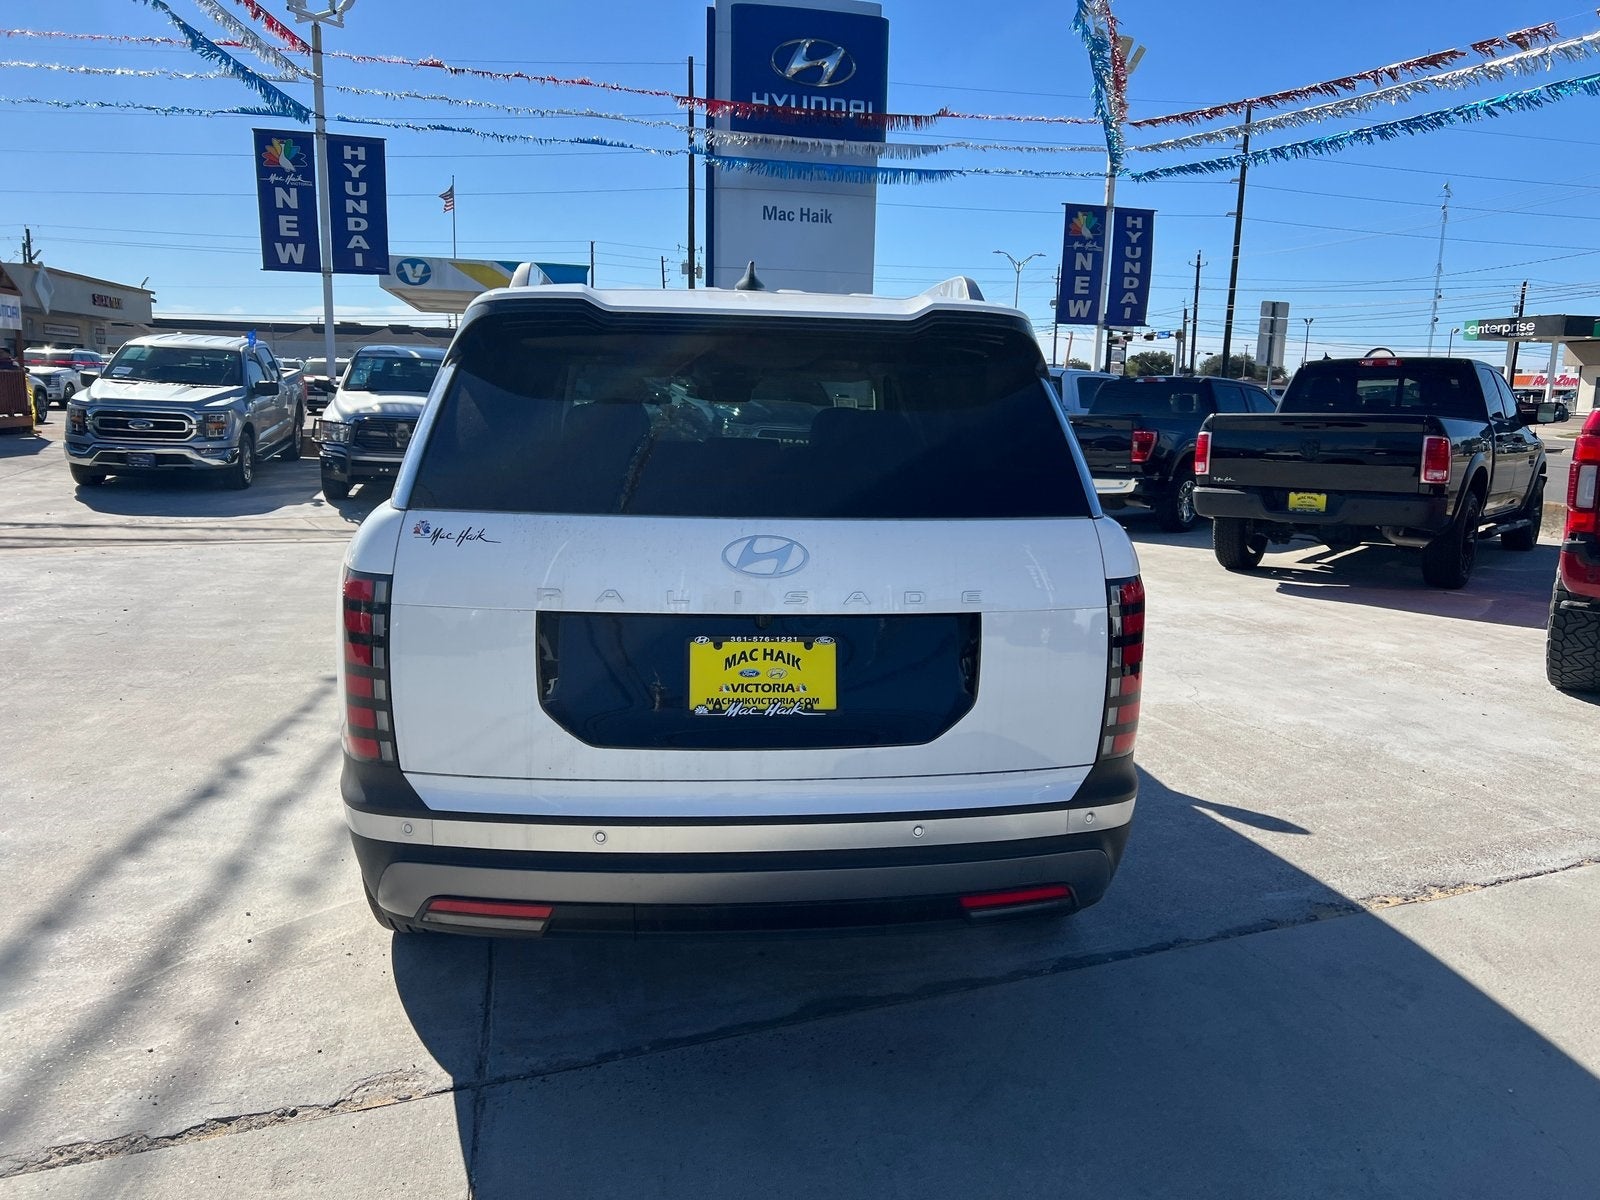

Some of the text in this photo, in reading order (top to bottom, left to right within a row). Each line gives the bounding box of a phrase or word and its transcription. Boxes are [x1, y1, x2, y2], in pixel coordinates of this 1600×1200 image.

[343, 145, 370, 267] HYUNDAI
[762, 205, 833, 224] Mac Haik
[274, 187, 306, 264] NEW
[1120, 216, 1143, 319] HYUNDAI
[1068, 252, 1093, 318] NEW
[1465, 320, 1536, 336] enterprise
[429, 526, 493, 547] Mac Haik
[536, 587, 984, 605] PALISADE
[724, 648, 802, 671] MAC HAIK
[741, 669, 759, 677] Ford
[731, 683, 795, 693] VICTORIA
[725, 701, 813, 717] Mac Haik
